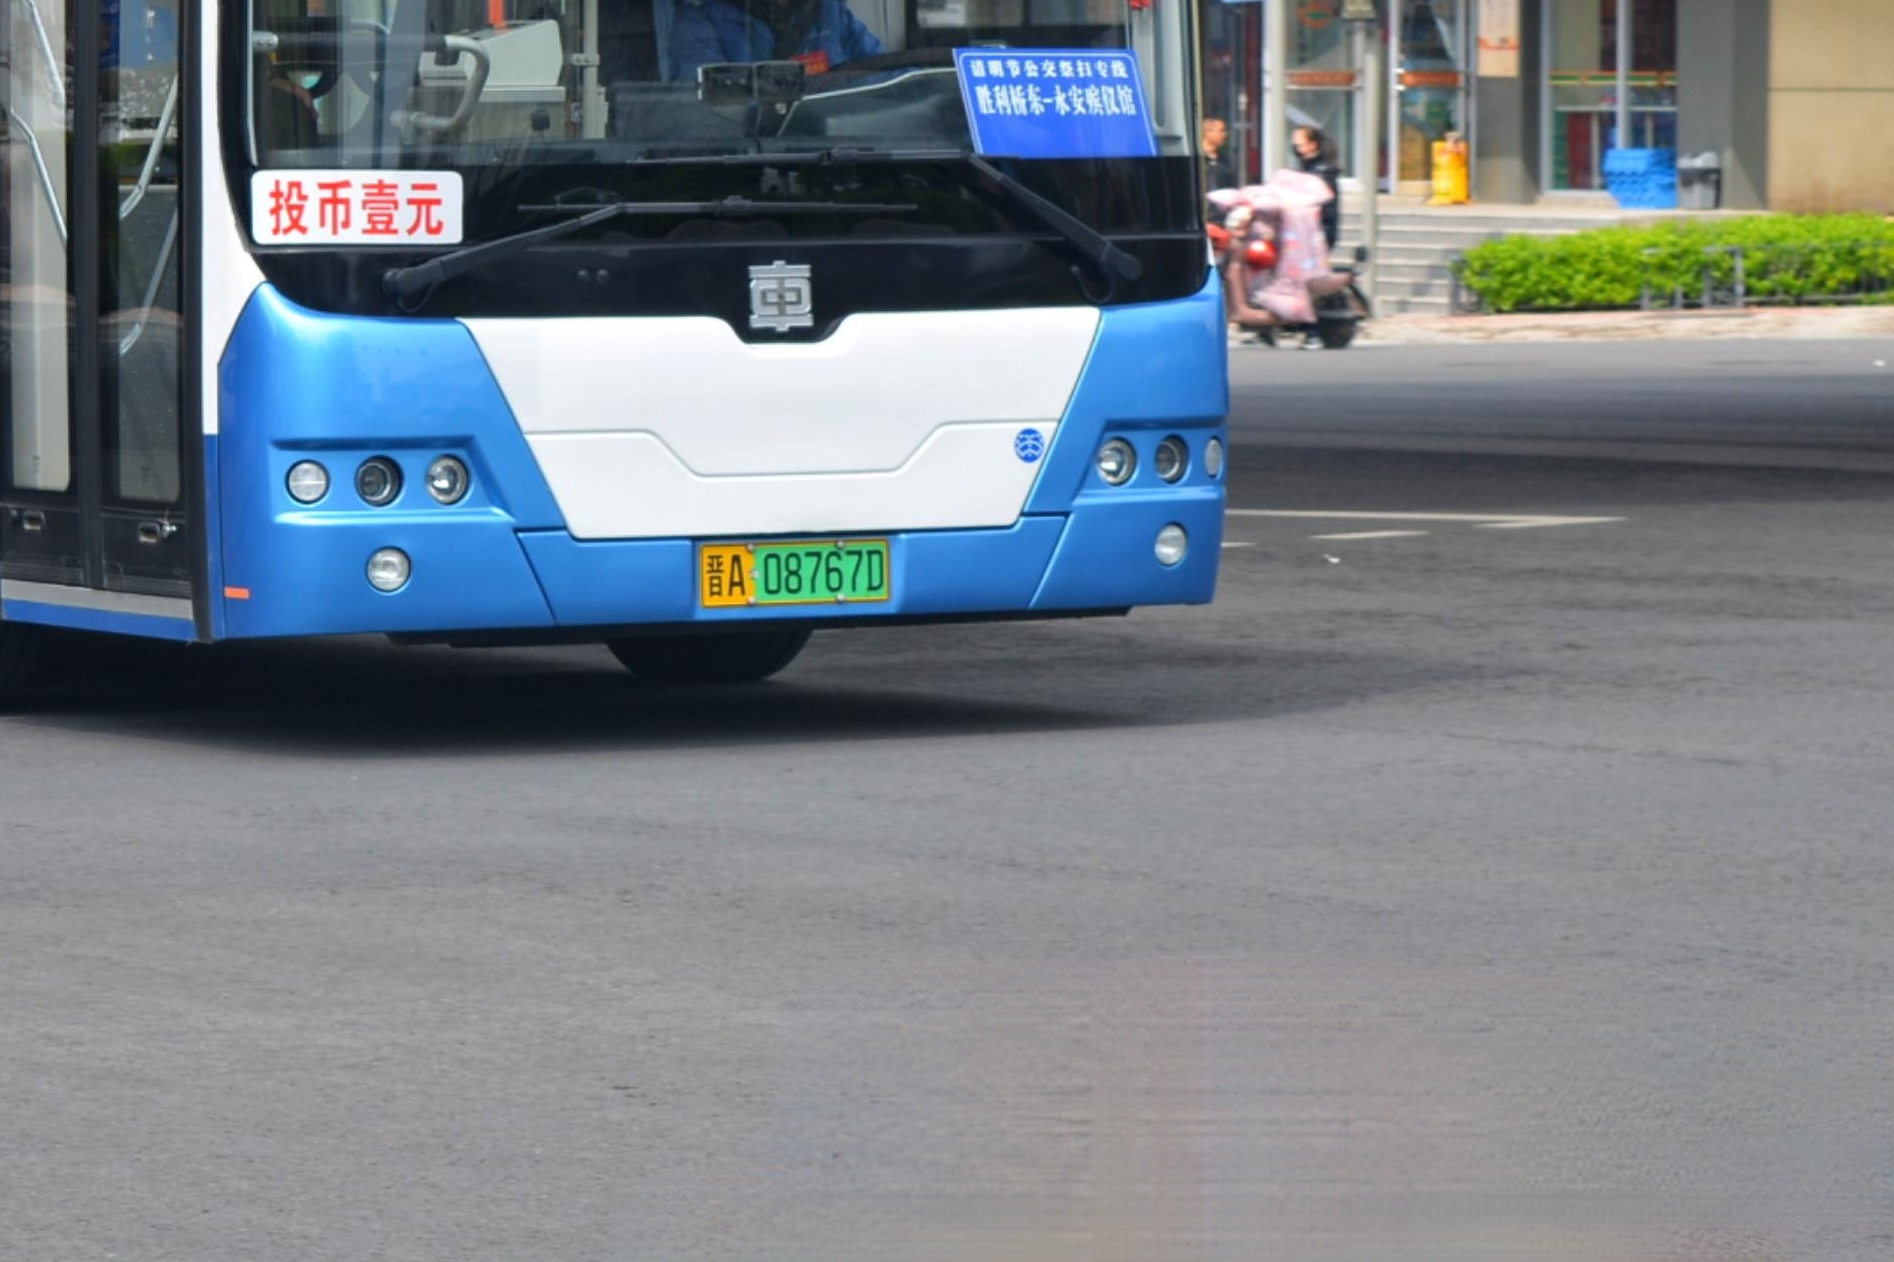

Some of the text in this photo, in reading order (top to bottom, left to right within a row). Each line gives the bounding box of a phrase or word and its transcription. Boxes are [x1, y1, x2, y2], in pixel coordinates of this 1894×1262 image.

[969, 59, 1129, 79] 清明节公交祭扫专线
[269, 179, 444, 236] 投币壹元
[706, 548, 885, 598] 晋A 08767D
